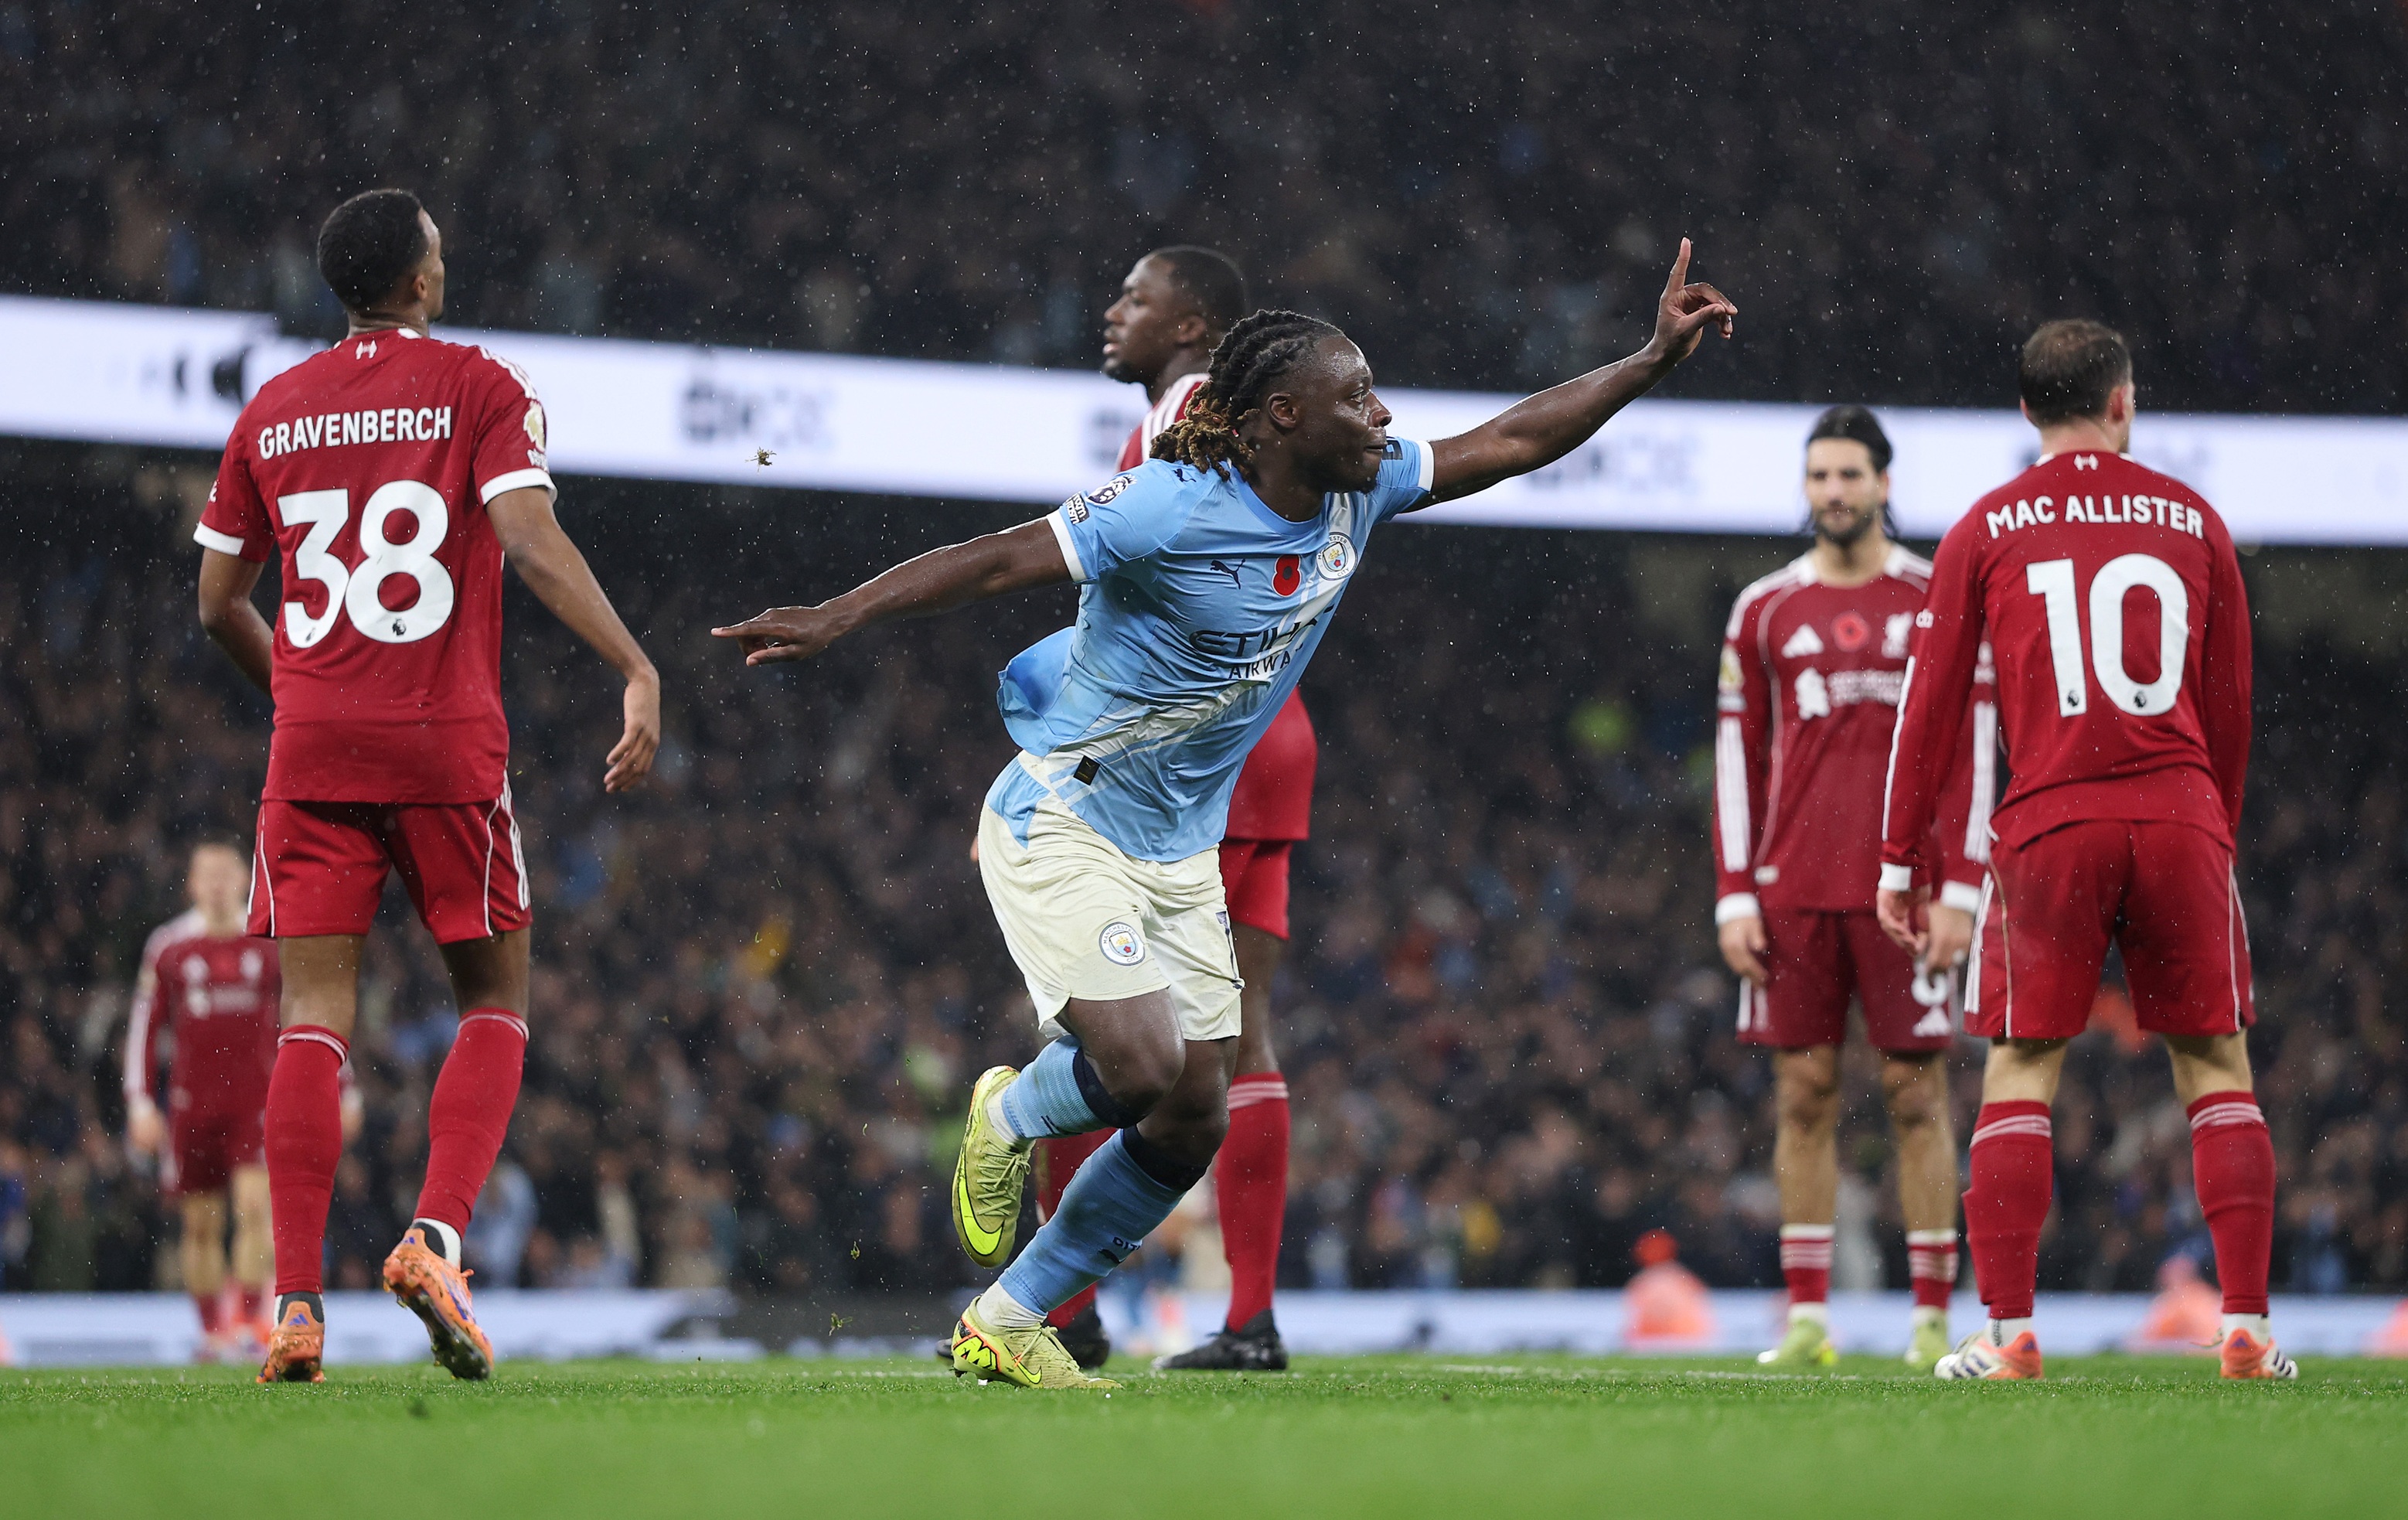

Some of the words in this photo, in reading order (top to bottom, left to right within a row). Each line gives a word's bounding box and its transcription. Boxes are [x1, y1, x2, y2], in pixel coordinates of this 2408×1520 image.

[257, 406, 451, 460] GRAVENBERCH
[1985, 496, 2056, 539] MAC
[2065, 494, 2204, 540] ALLISTER
[278, 480, 455, 648] 38
[1337, 567, 1350, 577] CITY
[2025, 553, 2190, 717] 10
[1103, 925, 1136, 944] MANCHESTER
